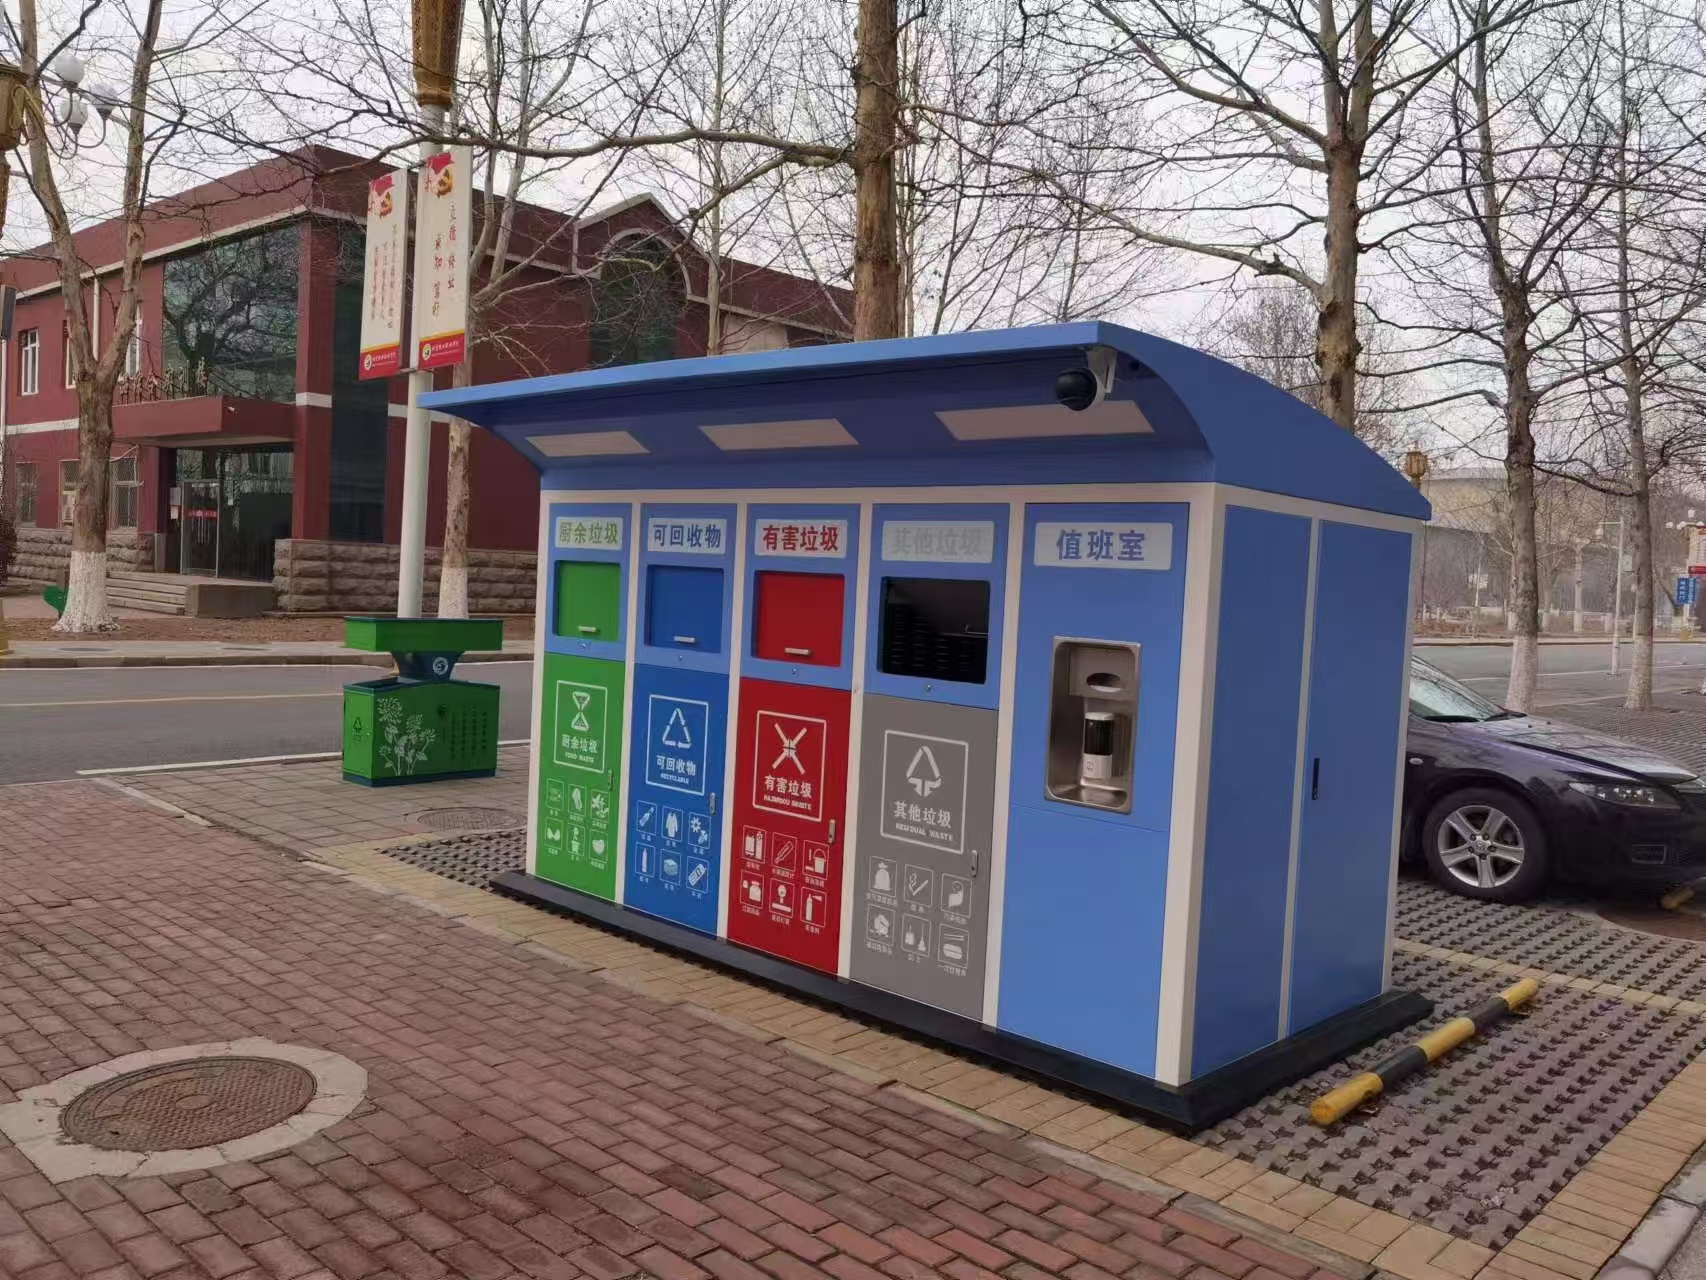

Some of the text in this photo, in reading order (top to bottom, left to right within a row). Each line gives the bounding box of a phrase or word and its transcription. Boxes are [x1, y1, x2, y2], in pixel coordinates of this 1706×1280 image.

[558, 521, 618, 545] 厨余垃圾
[652, 523, 722, 548] 可回收物
[762, 524, 839, 551] 有害垃圾
[892, 527, 984, 557] 其他垃圾
[1056, 529, 1146, 562] 值班室
[656, 754, 697, 777] 可回收物
[763, 773, 812, 799] 有害垃圾
[893, 800, 952, 829] 其他垃圾
